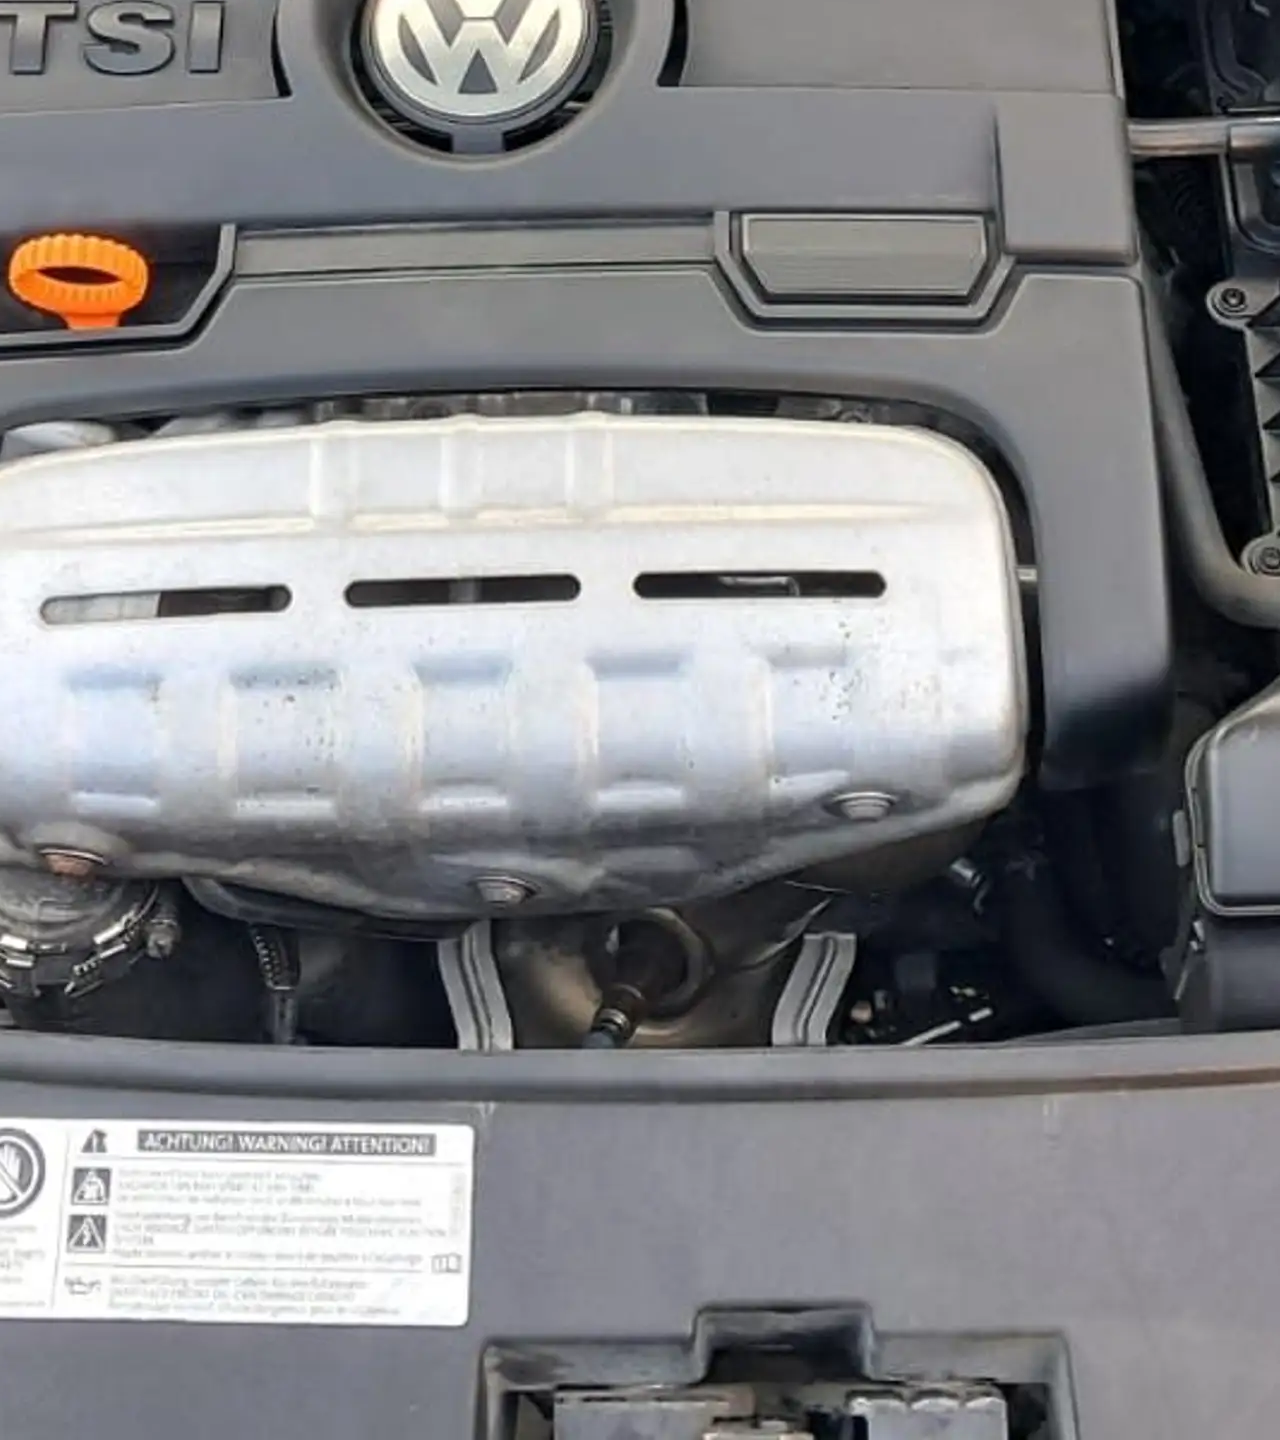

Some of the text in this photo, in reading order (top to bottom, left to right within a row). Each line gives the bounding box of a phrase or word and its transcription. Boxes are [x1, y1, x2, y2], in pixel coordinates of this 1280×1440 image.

[144, 1131, 431, 1154] ACHTUNG! WARNING! ATTENTION!
